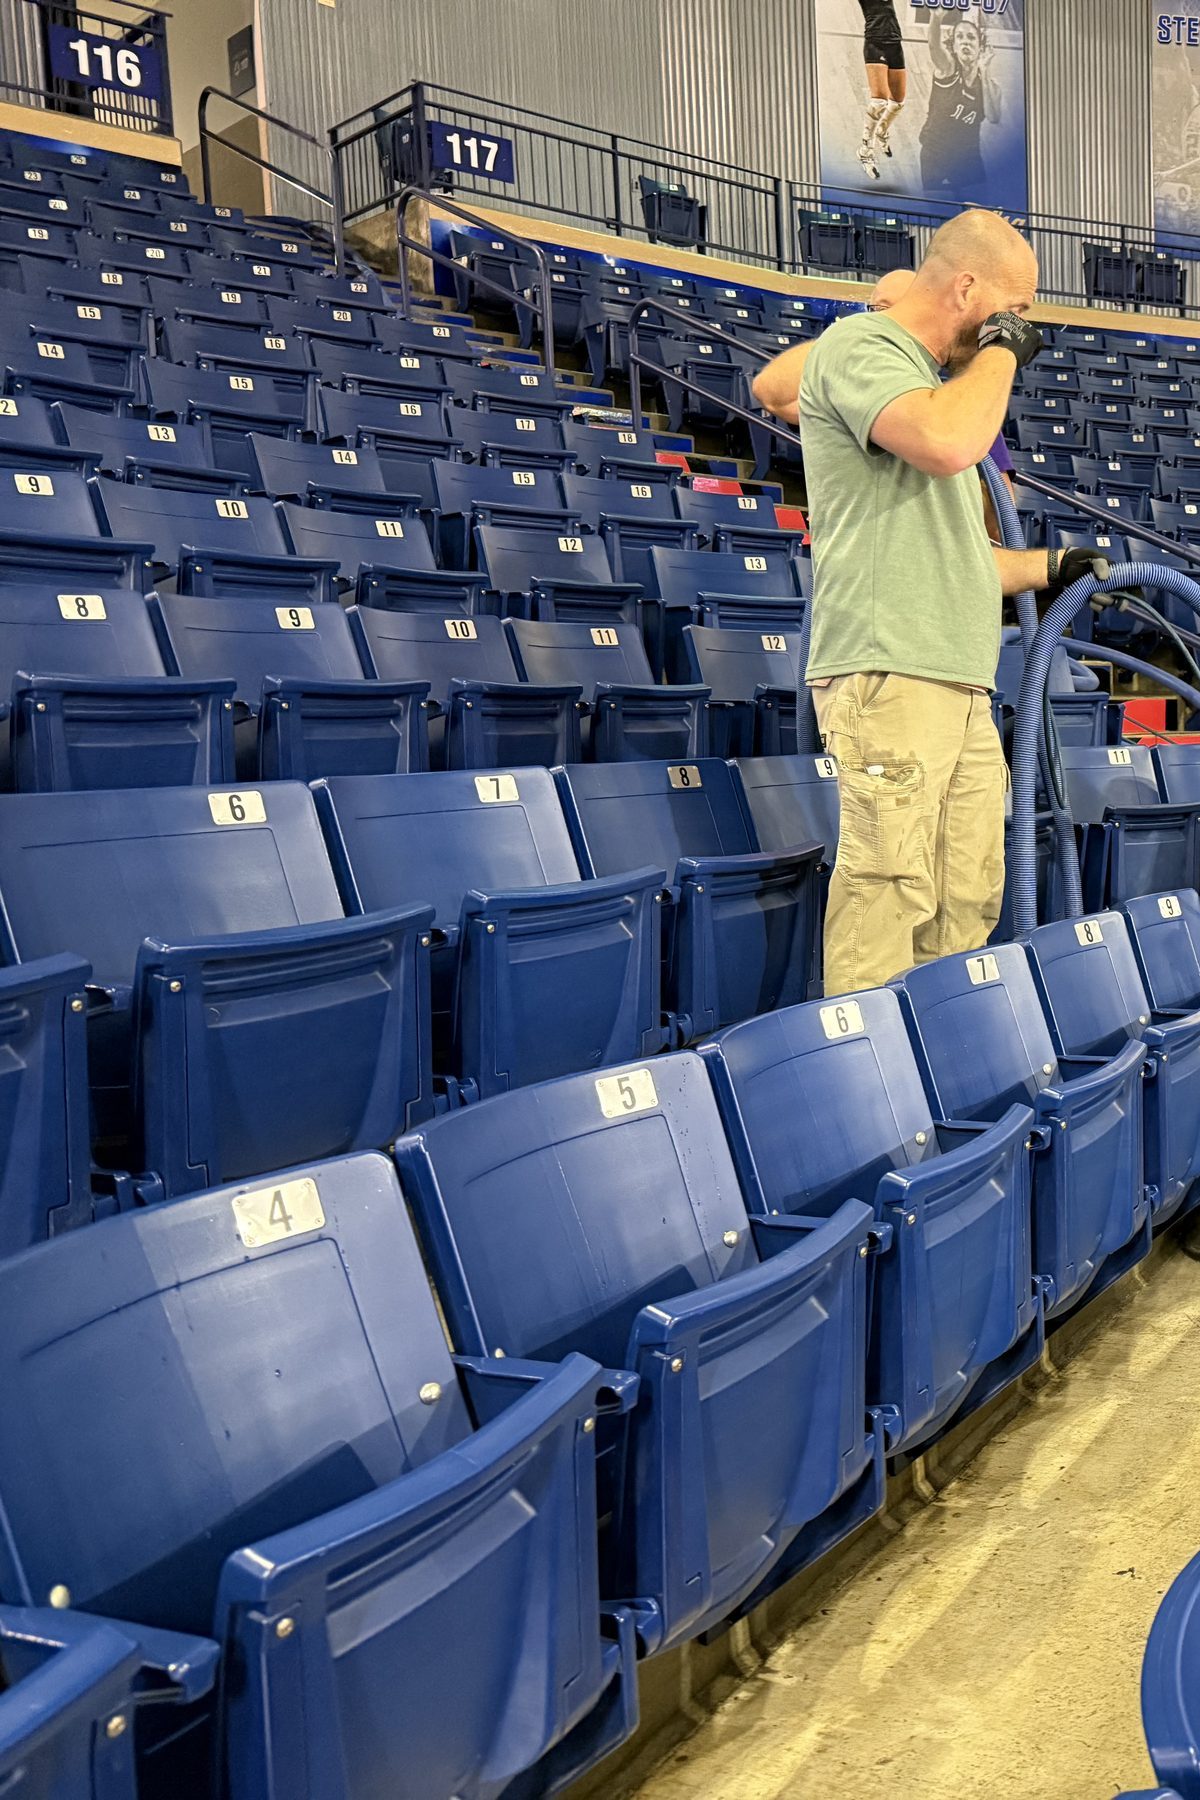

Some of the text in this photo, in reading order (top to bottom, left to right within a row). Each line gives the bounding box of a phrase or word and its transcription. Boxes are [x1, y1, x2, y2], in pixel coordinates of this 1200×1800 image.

[69, 39, 141, 88] 116
[950, 104, 977, 125] 14
[446, 132, 499, 172] 117
[43, 345, 58, 357] 14
[235, 378, 248, 389] 15
[154, 427, 170, 440] 13
[623, 433, 633, 443] 18
[338, 452, 352, 463] 14
[28, 476, 40, 493] 9
[223, 501, 241, 516] 10
[382, 522, 397, 536] 11
[564, 539, 578, 550] 12
[750, 558, 762, 569] 13
[75, 597, 89, 617] 8
[289, 609, 301, 627] 9
[451, 621, 470, 637] 10
[597, 630, 612, 644] 11
[767, 636, 781, 649] 12
[1113, 750, 1125, 763] 11
[824, 759, 833, 775] 9
[679, 767, 690, 786] 8
[489, 778, 500, 799] 7
[229, 794, 245, 821] 6
[1166, 899, 1174, 915] 9
[1084, 923, 1094, 942] 8
[977, 958, 986, 980] 7
[835, 1007, 849, 1033] 6
[617, 1076, 636, 1110] 5
[269, 1190, 293, 1232] 4
